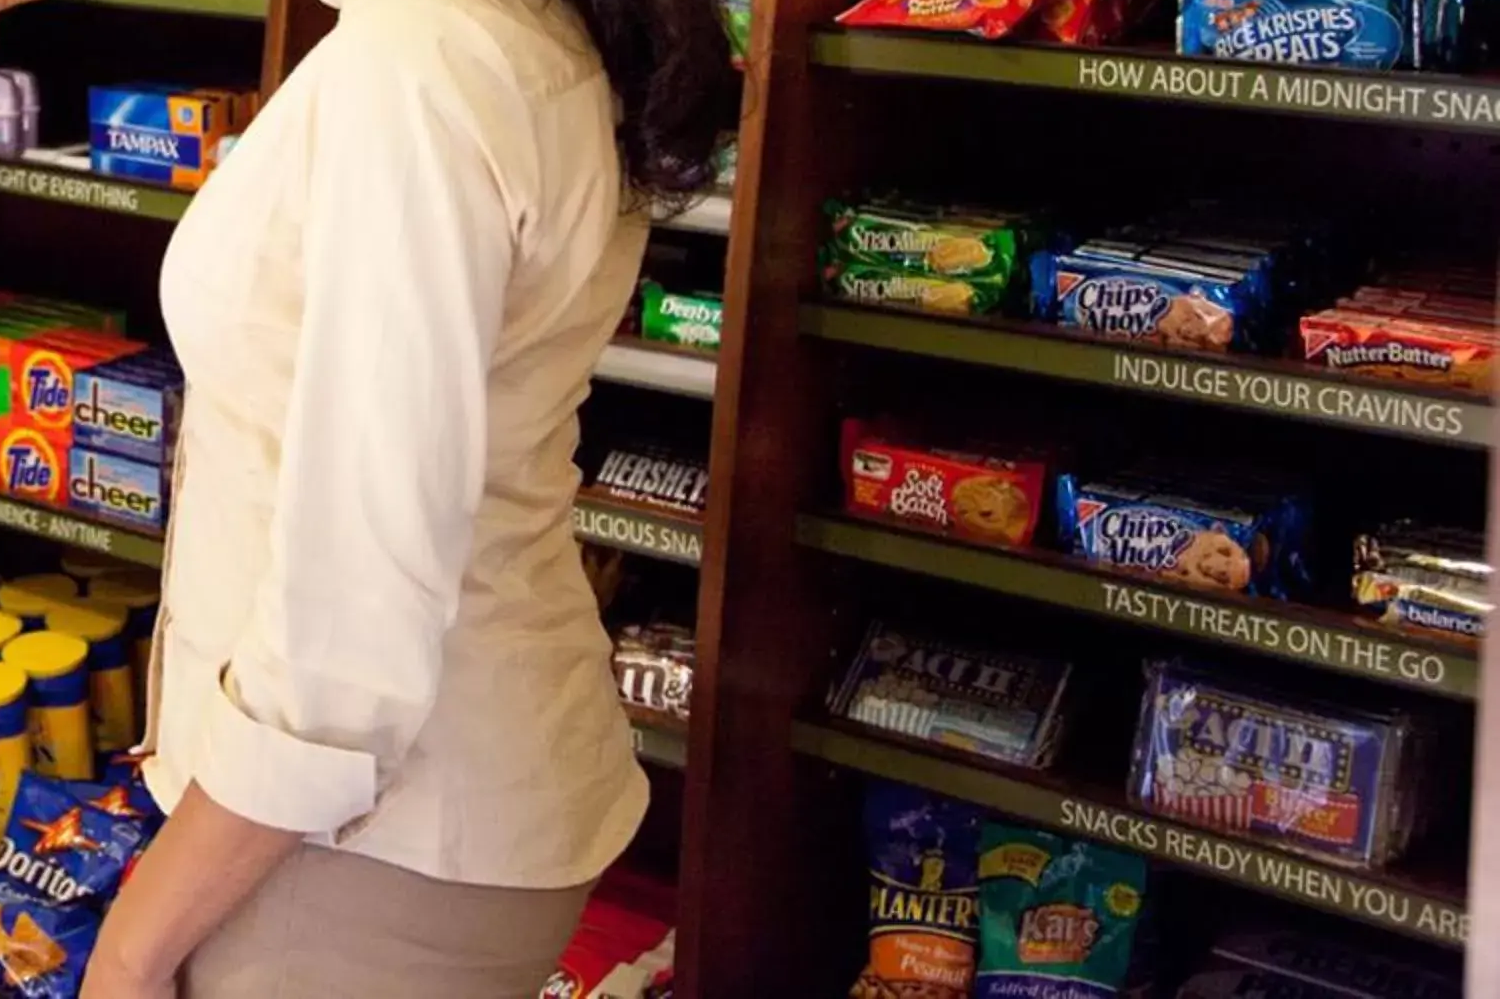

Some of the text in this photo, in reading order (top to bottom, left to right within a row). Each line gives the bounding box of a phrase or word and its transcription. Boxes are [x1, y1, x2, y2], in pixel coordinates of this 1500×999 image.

[1255, 7, 1357, 38] KRISPIES
[1078, 57, 1144, 90] HOW
[1151, 65, 1244, 99] ABOUT
[1250, 74, 1269, 101] A
[1276, 75, 1425, 117] MIDNIGHT
[106, 128, 181, 160] TAMPAX
[27, 170, 50, 193] OF
[49, 174, 139, 211] EVERYTHING
[1077, 282, 1159, 312] Chips
[1326, 341, 1452, 369] Nutter Butter
[28, 367, 69, 411] Tide
[74, 380, 160, 439] cheer
[1114, 354, 1464, 436] INDULGE YOUR CRAVINGS
[7, 447, 51, 491] Tide
[71, 456, 157, 513] cheer
[903, 469, 944, 500] Soft
[891, 488, 948, 525] Batch
[1101, 511, 1179, 540] Chips
[48, 514, 113, 553] ANYTIME
[1102, 583, 1445, 684] TASTY TREATS ON THE GO
[1060, 799, 1160, 851] SNACKS
[1165, 829, 1253, 875] READY
[1257, 857, 1342, 904] WHEN
[1348, 881, 1411, 923] YOU
